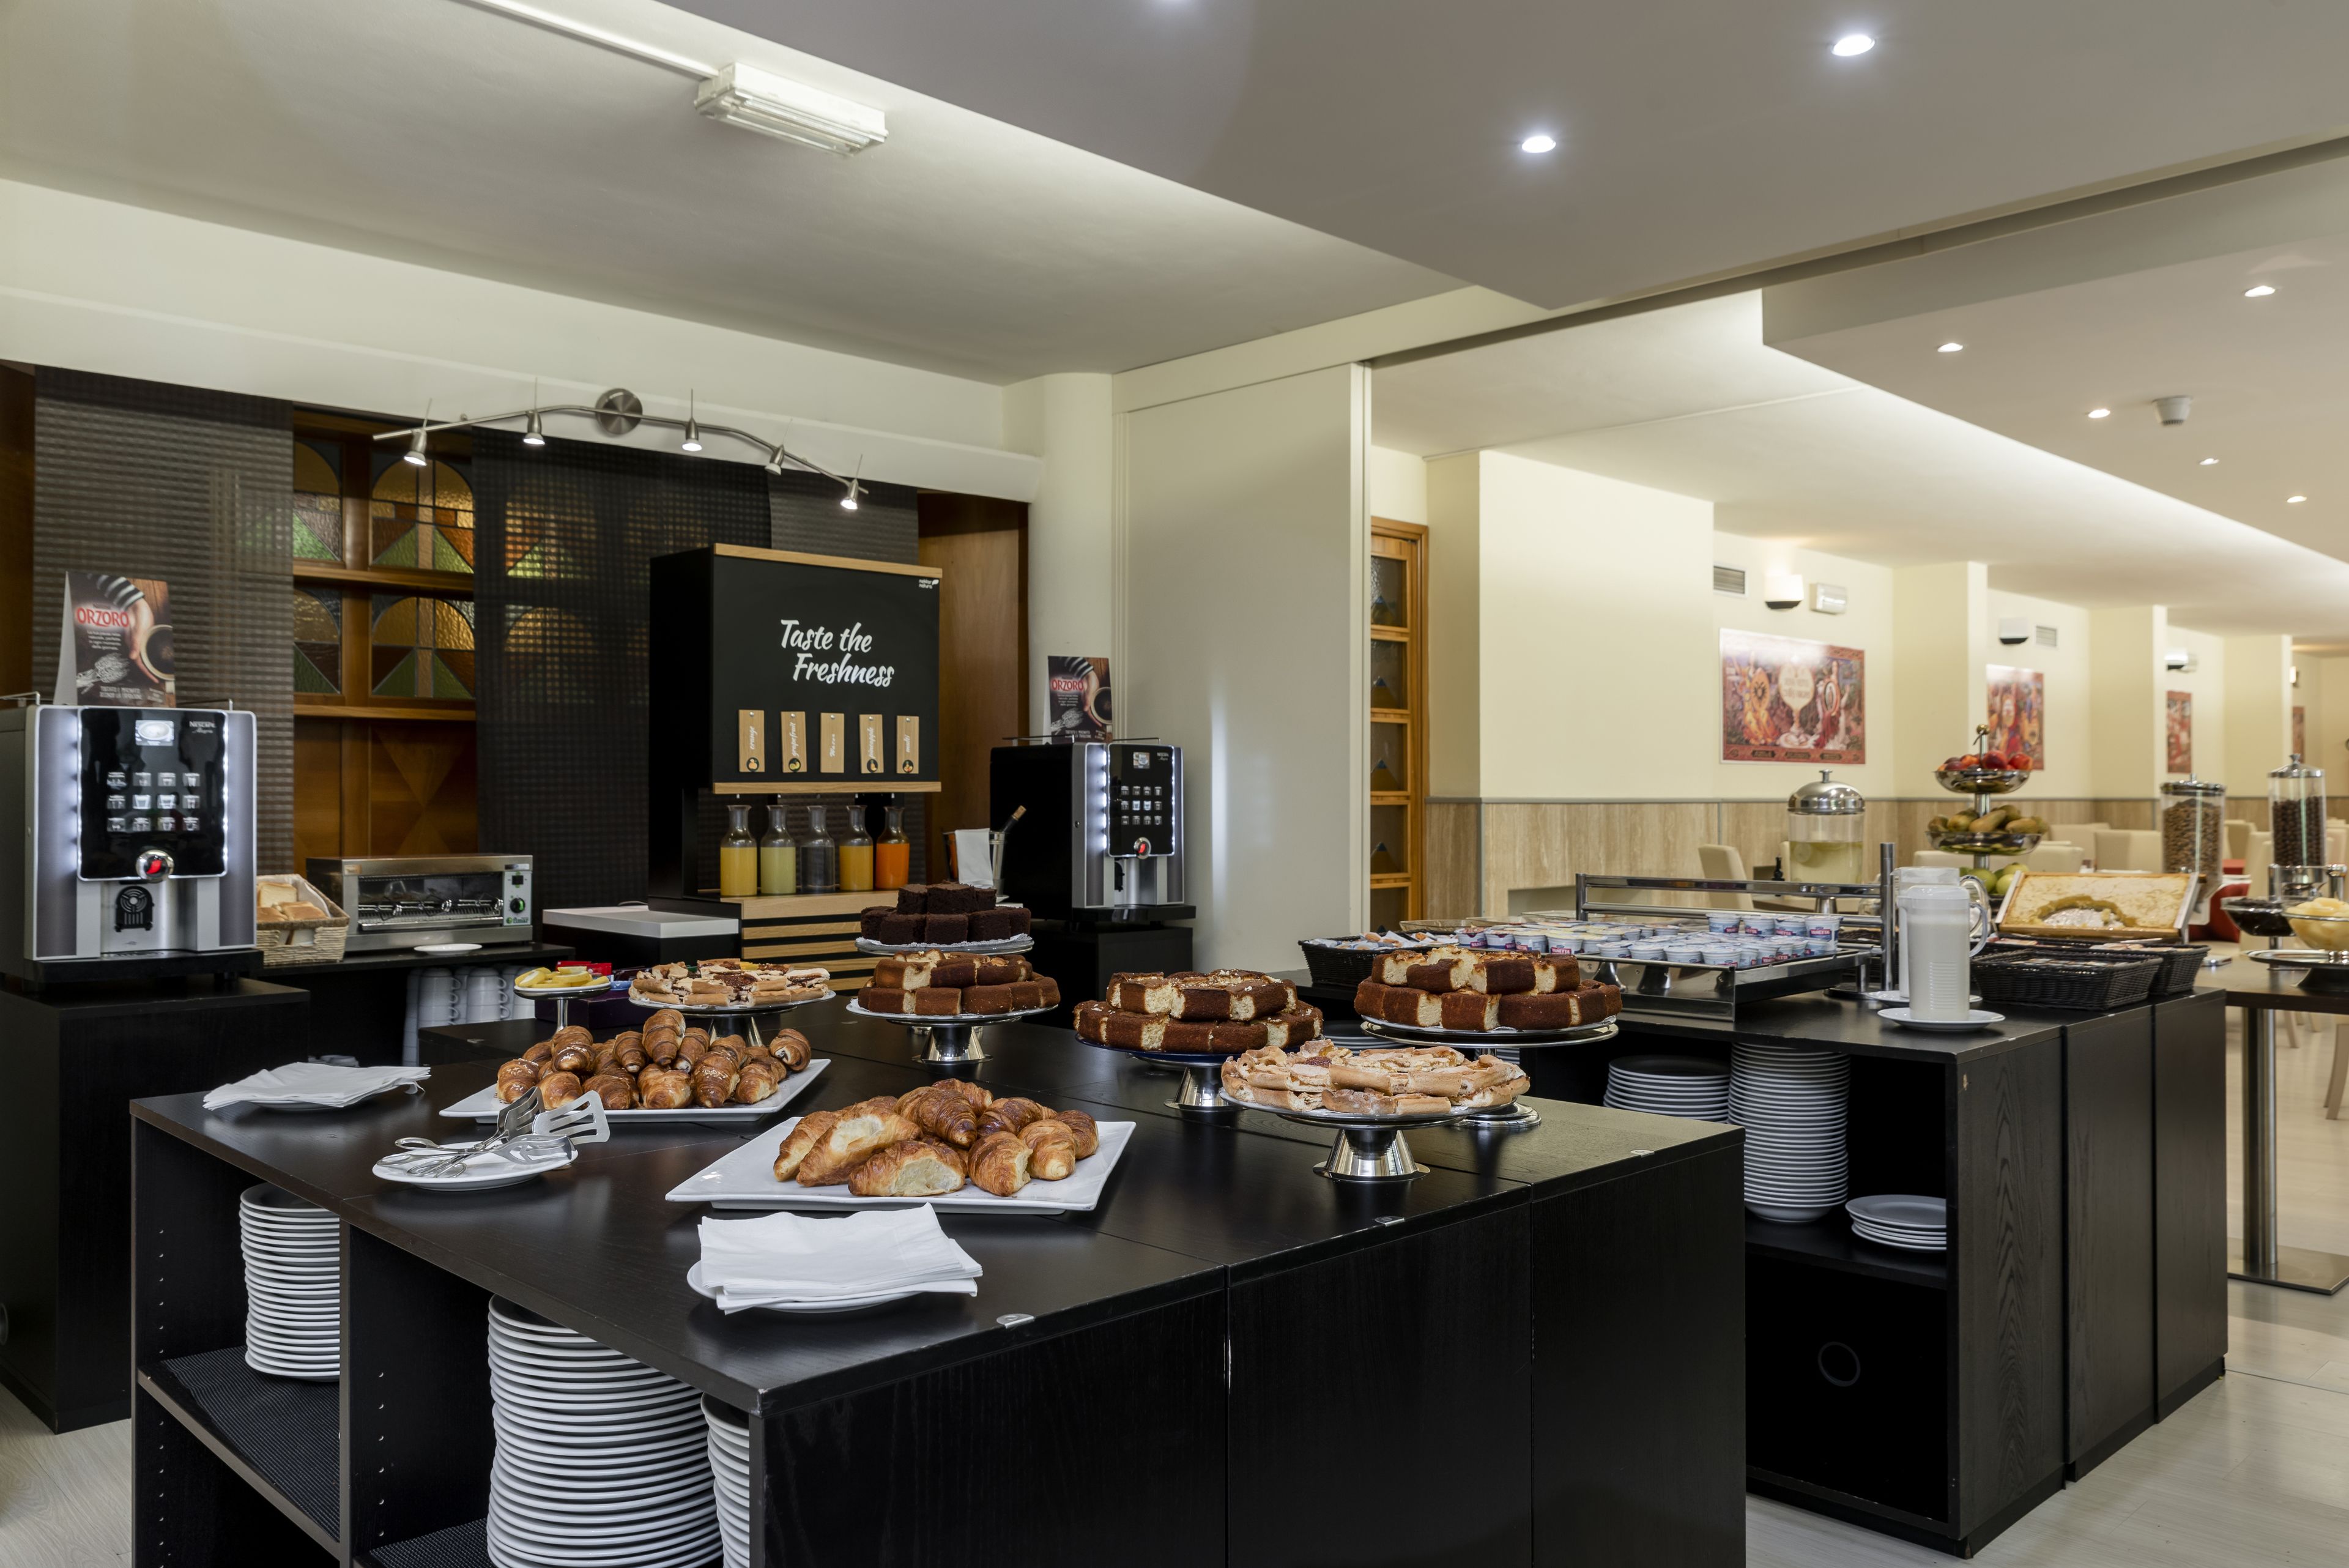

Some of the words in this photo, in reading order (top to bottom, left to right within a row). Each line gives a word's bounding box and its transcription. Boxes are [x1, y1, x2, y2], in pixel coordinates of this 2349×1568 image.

[77, 607, 130, 627] ORZORO
[781, 619, 833, 650] Taste
[839, 622, 872, 653] the
[793, 653, 894, 687] Freshness
[1052, 679, 1084, 692] ORZORO
[749, 726, 758, 749] orange
[789, 722, 800, 757] grapefruit
[867, 727, 876, 759] pineapple
